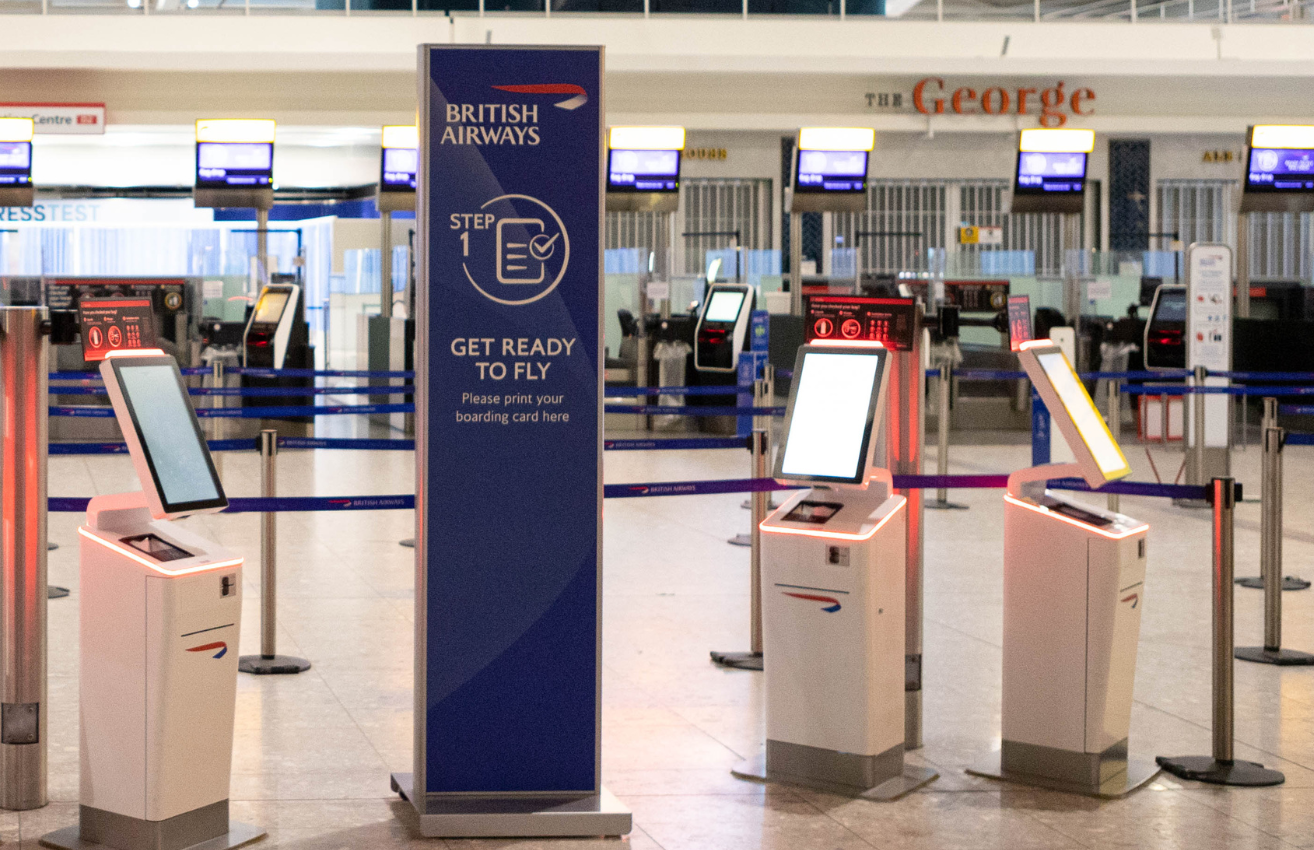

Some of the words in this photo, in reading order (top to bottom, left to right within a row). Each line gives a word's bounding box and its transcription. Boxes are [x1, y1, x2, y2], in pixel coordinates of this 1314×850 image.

[865, 93, 903, 107] THE
[913, 77, 1096, 128] George
[32, 113, 73, 125] Centre
[446, 103, 539, 124] BRITISH
[440, 126, 541, 146] AIRWAYS
[450, 213, 495, 229] STEP
[460, 231, 469, 257] 1
[451, 338, 495, 356] GET
[502, 338, 576, 356] READY
[475, 362, 507, 380] TO
[514, 362, 551, 380] FLY
[462, 393, 501, 404] Please
[504, 393, 533, 406] print
[536, 394, 564, 405] your
[456, 411, 509, 424] boarding
[512, 411, 539, 422] card
[543, 411, 570, 422] here
